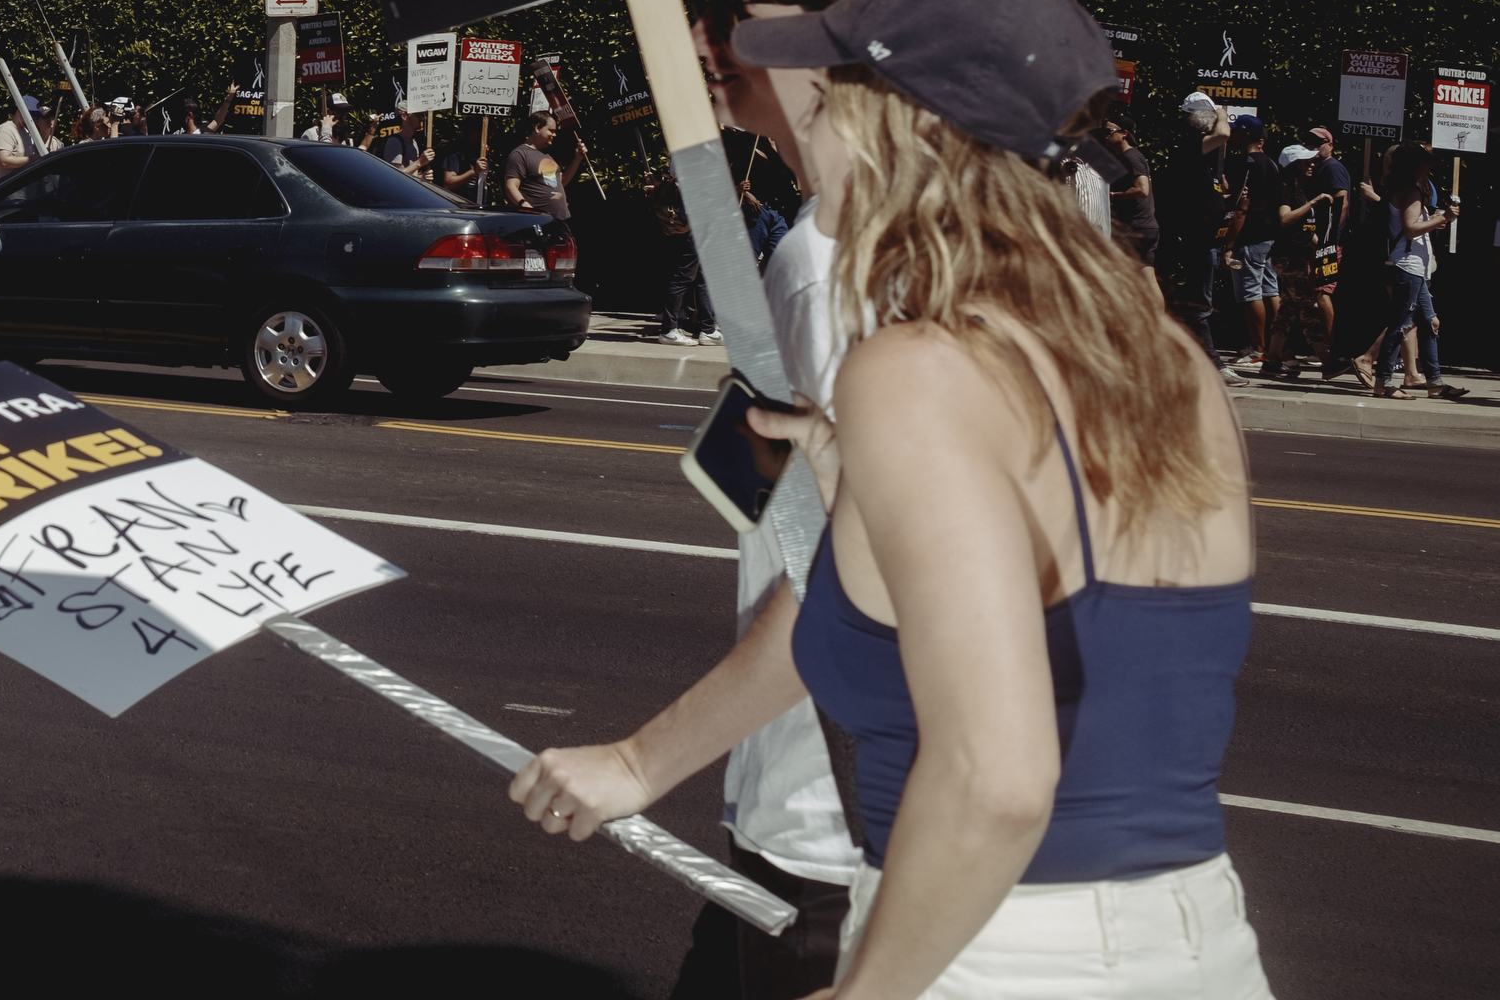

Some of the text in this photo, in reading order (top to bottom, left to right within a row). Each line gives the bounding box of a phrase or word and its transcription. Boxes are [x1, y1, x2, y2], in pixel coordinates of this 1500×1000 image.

[300, 19, 338, 31] WRITERS GUILD
[308, 36, 332, 46] AMERICA
[1115, 30, 1138, 42] GUILD
[468, 40, 516, 50] WRITERS
[316, 51, 326, 59] ON
[417, 47, 448, 58] WGAW
[466, 53, 516, 62] AMERICA
[469, 47, 502, 56] GUILD
[1349, 53, 1400, 64] WRITERS
[1350, 59, 1386, 69] GUILD
[302, 58, 342, 77] STRIKE!
[1346, 66, 1400, 77] AMERICA
[1438, 67, 1487, 81] WRITERS GUILD
[1349, 80, 1397, 92] WE'VE GOT
[1196, 85, 1258, 100] STRIKE!
[1437, 83, 1486, 106] STRIKE!
[462, 103, 512, 116] STRIKE
[611, 104, 654, 126] STRIKE!
[1351, 106, 1393, 119] NETFLIX
[1342, 122, 1396, 138] STRIKE
